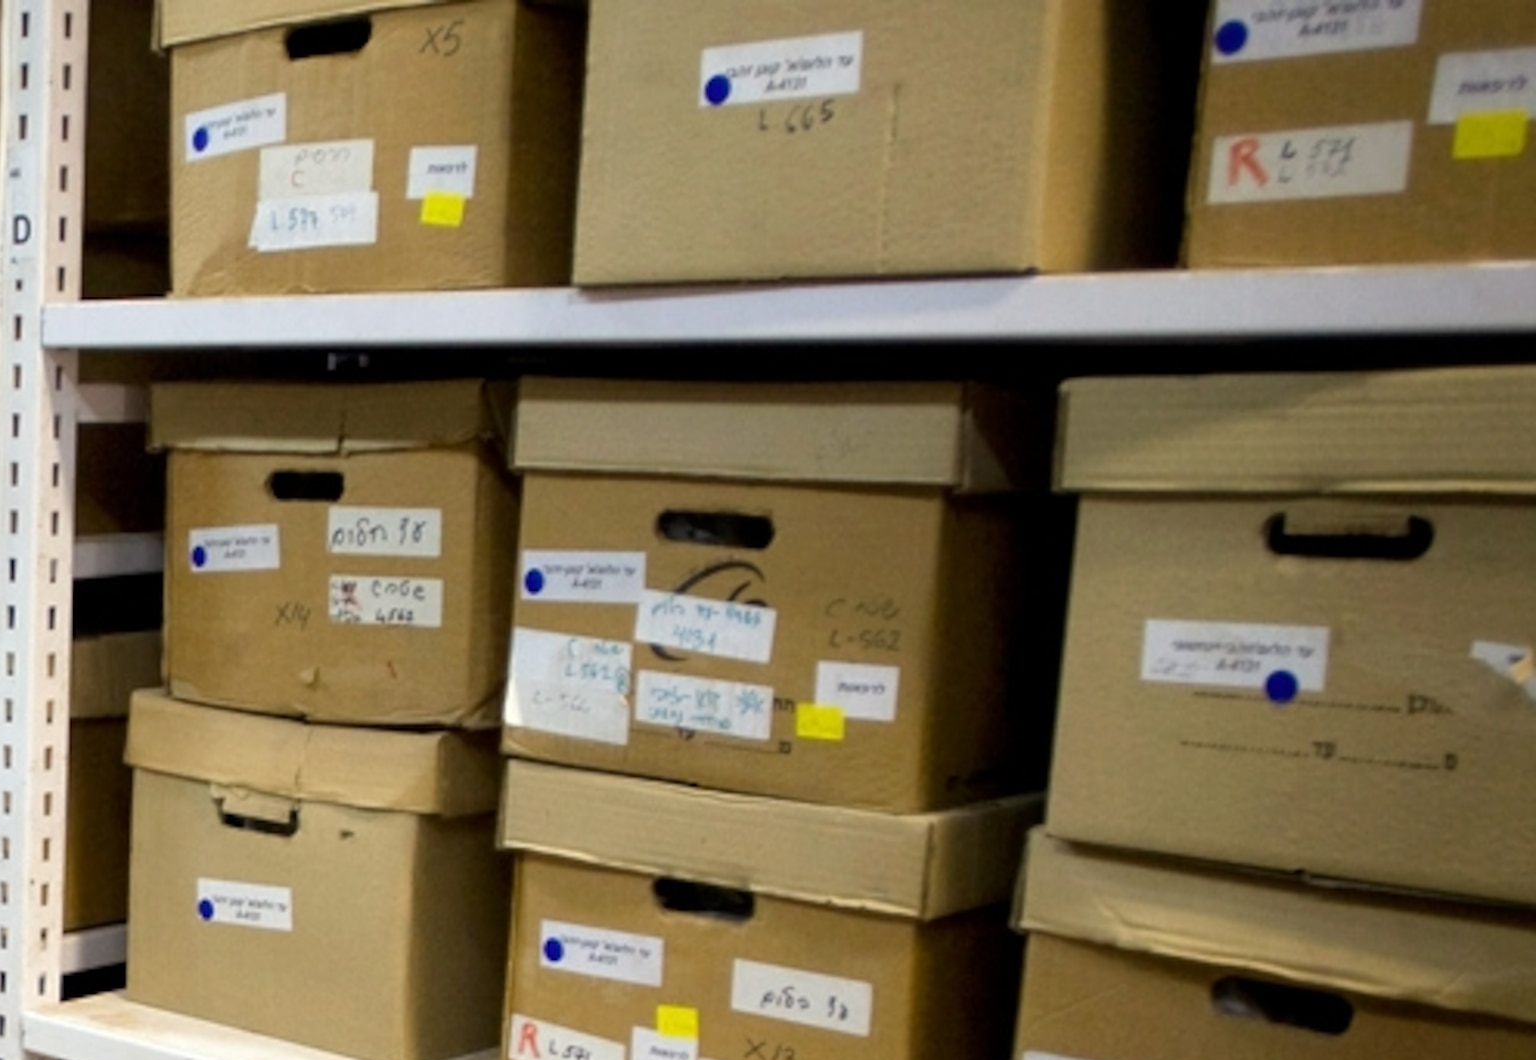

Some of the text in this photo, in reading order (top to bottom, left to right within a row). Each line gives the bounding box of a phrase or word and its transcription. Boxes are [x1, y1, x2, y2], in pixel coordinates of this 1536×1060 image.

[418, 19, 465, 56] X5
[1228, 137, 1269, 188] R
[12, 214, 32, 245] D
[518, 1022, 541, 1059] R
